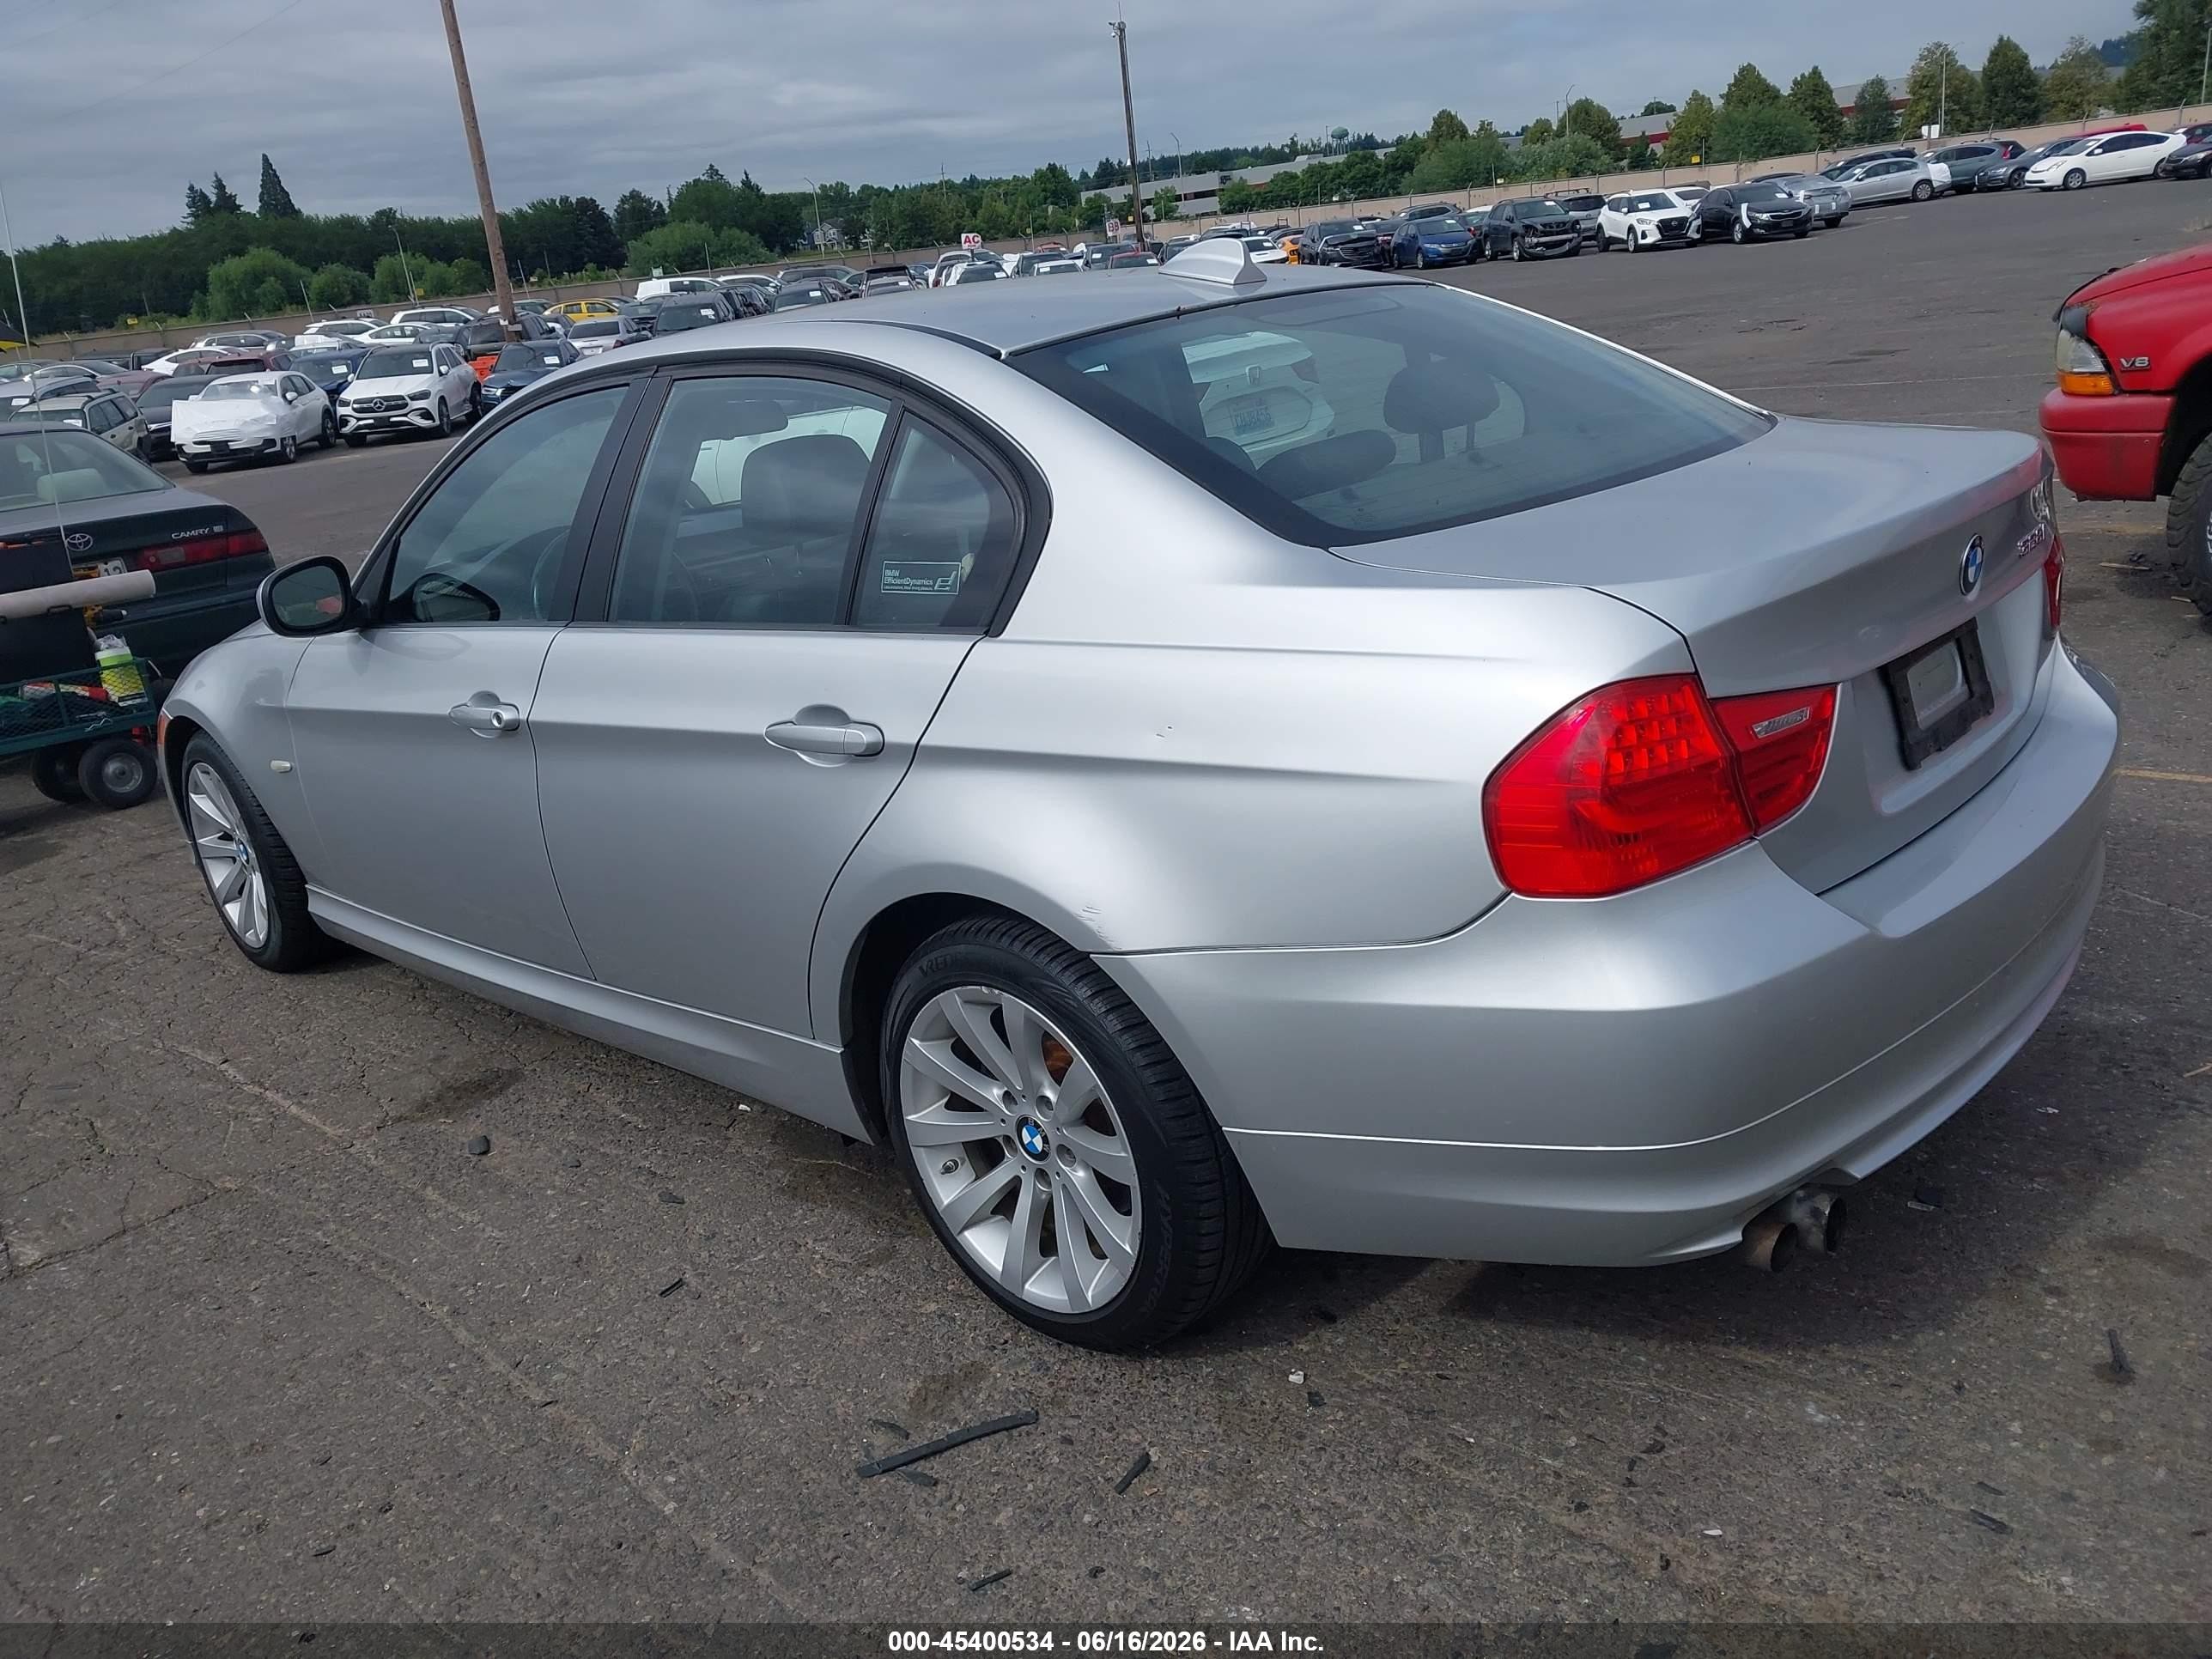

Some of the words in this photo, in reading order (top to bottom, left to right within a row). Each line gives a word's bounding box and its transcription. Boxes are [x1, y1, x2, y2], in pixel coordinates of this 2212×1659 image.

[963, 234, 981, 245] AC
[2120, 356, 2149, 368] V8
[171, 527, 210, 539] CAMRY
[884, 576, 933, 586] EfficientDynamics
